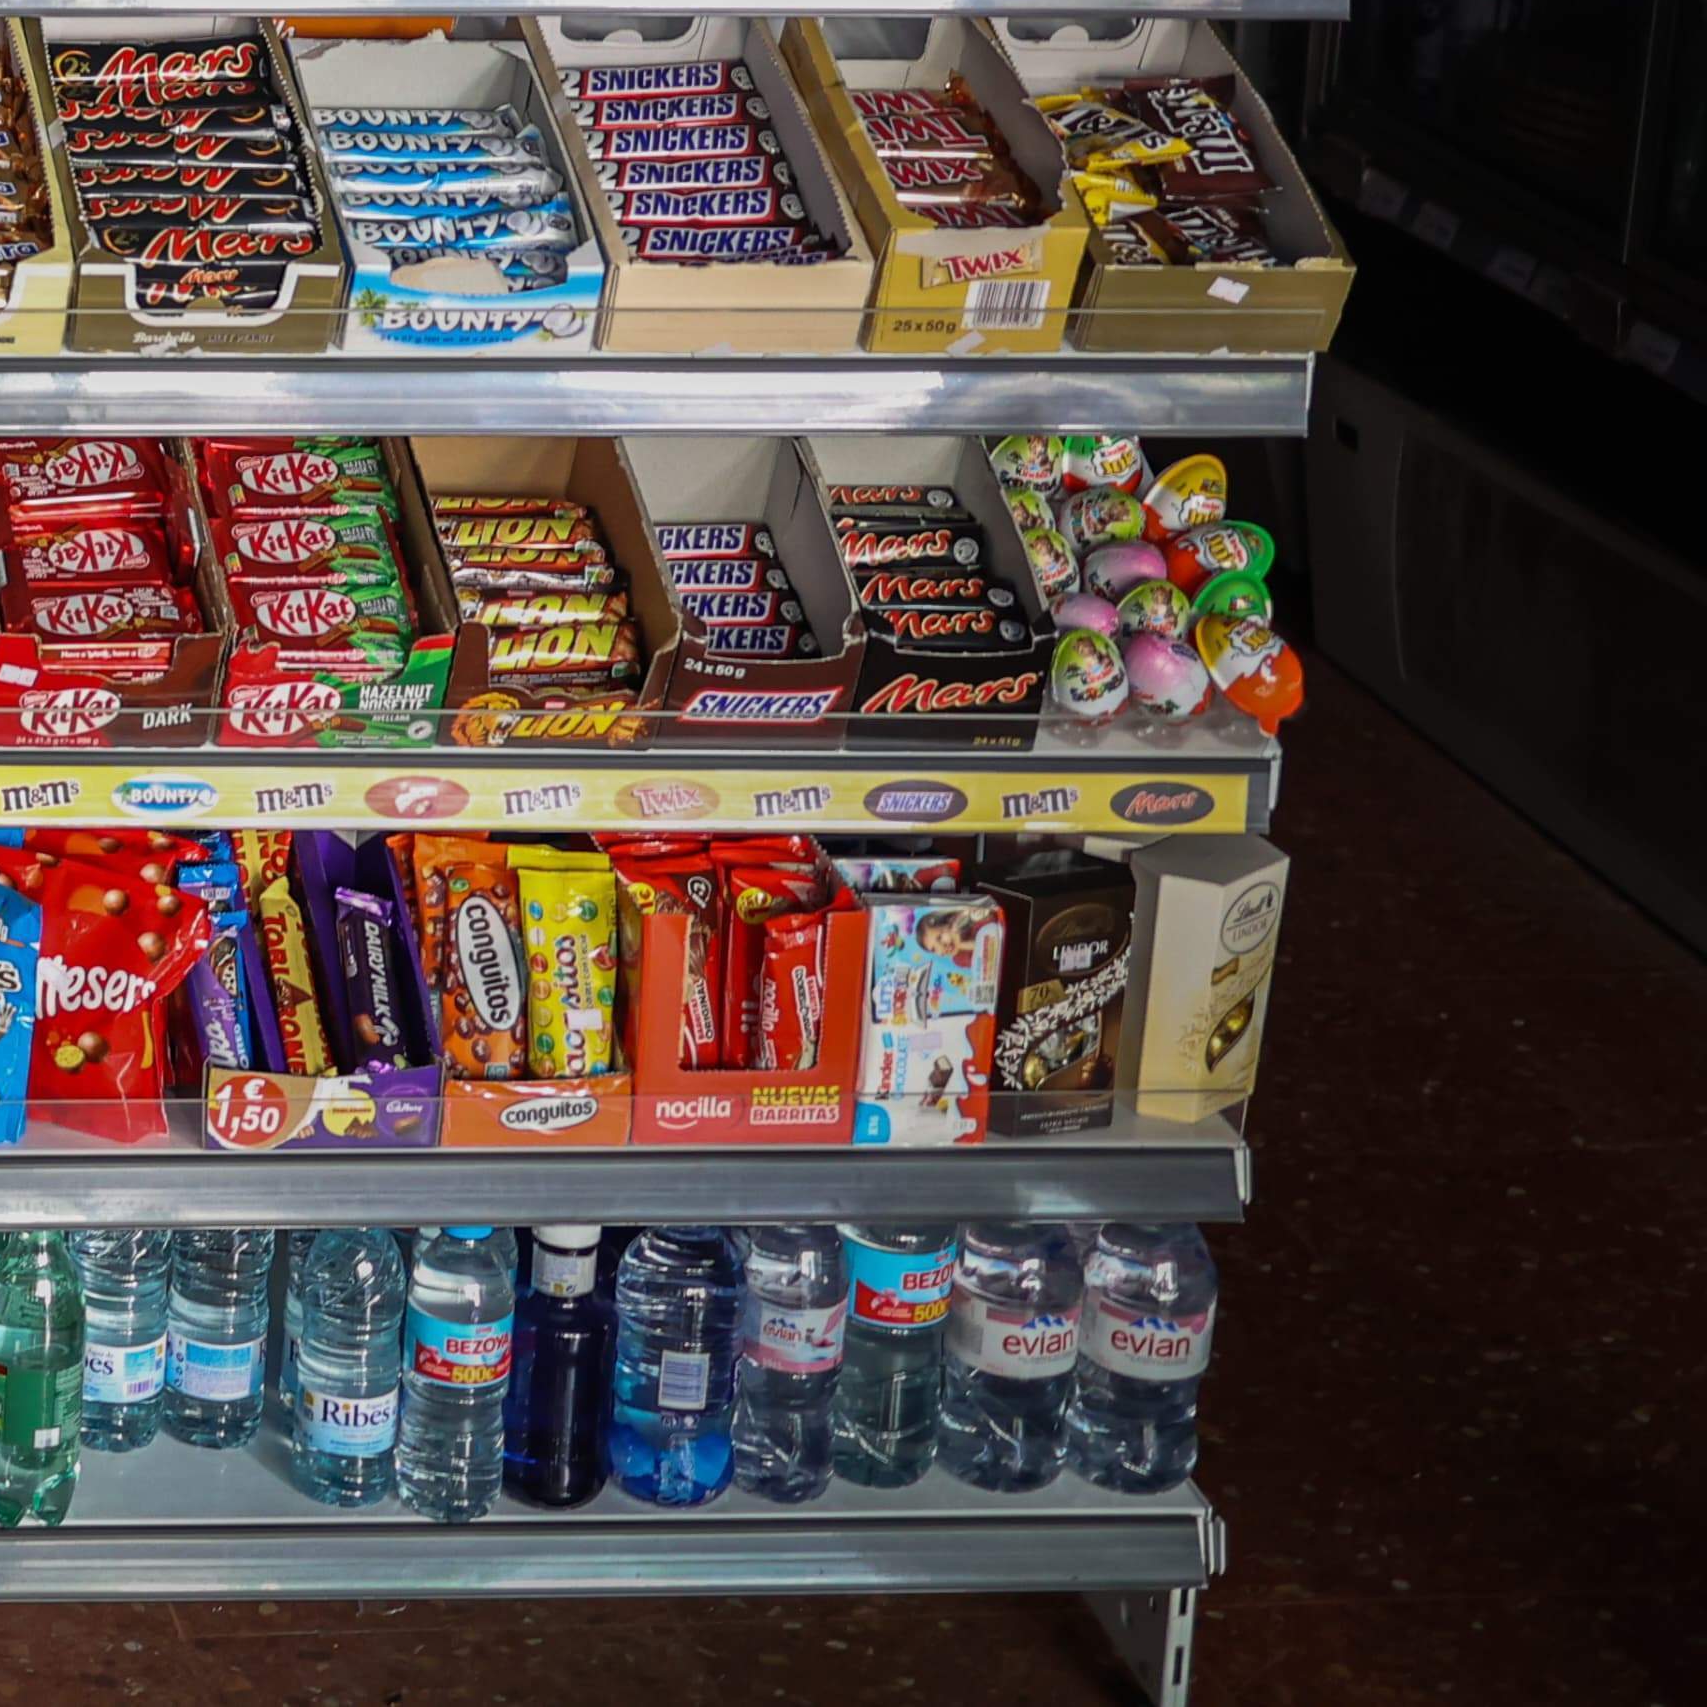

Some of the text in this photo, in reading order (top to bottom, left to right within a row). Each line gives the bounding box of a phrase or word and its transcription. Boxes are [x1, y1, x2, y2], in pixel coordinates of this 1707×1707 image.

[97, 44, 258, 91] Mars
[591, 64, 717, 90] SNICKERS
[944, 247, 1025, 278] TWIX
[384, 306, 545, 333] BOUNTY
[252, 454, 335, 492] KitKat
[361, 685, 434, 704] HAZELNUT
[690, 691, 834, 720] SNICKERS
[862, 672, 1035, 716] Mars
[27, 690, 117, 735] KitKat
[142, 704, 193, 730] DARK
[517, 696, 618, 738] LION
[130, 786, 200, 806] BOUNTY
[879, 792, 949, 812] SNICKERS
[1125, 791, 1195, 814] Mars
[463, 902, 513, 1026] conguitos
[656, 1097, 731, 1120] nocilla
[752, 1087, 840, 1105] NUEVAS
[506, 1098, 594, 1125] conguitos
[752, 1106, 839, 1123] BARRITAS
[1002, 1330, 1075, 1355] evian
[1111, 1330, 1192, 1356] evian
[322, 1396, 390, 1426] Ribes
